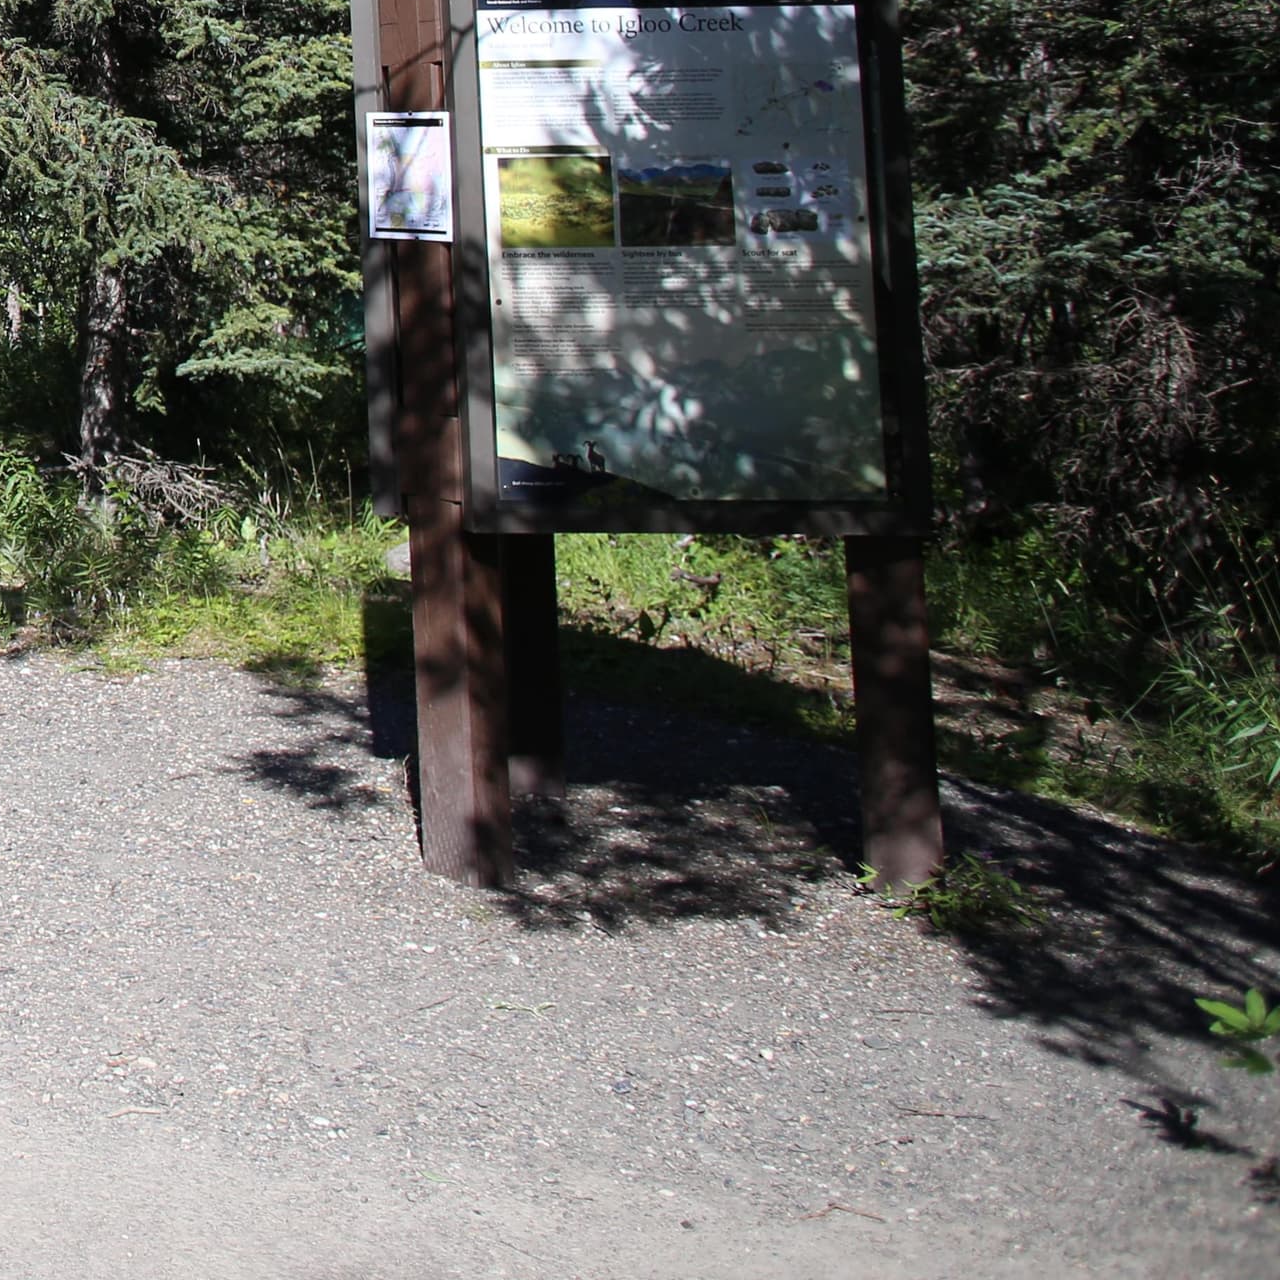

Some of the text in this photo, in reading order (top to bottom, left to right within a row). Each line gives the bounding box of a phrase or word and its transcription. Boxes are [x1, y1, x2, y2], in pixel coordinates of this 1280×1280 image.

[487, 11, 745, 39] Welcome to Igloo Creek
[502, 251, 536, 259] Embrace
[742, 249, 766, 257] Scout
